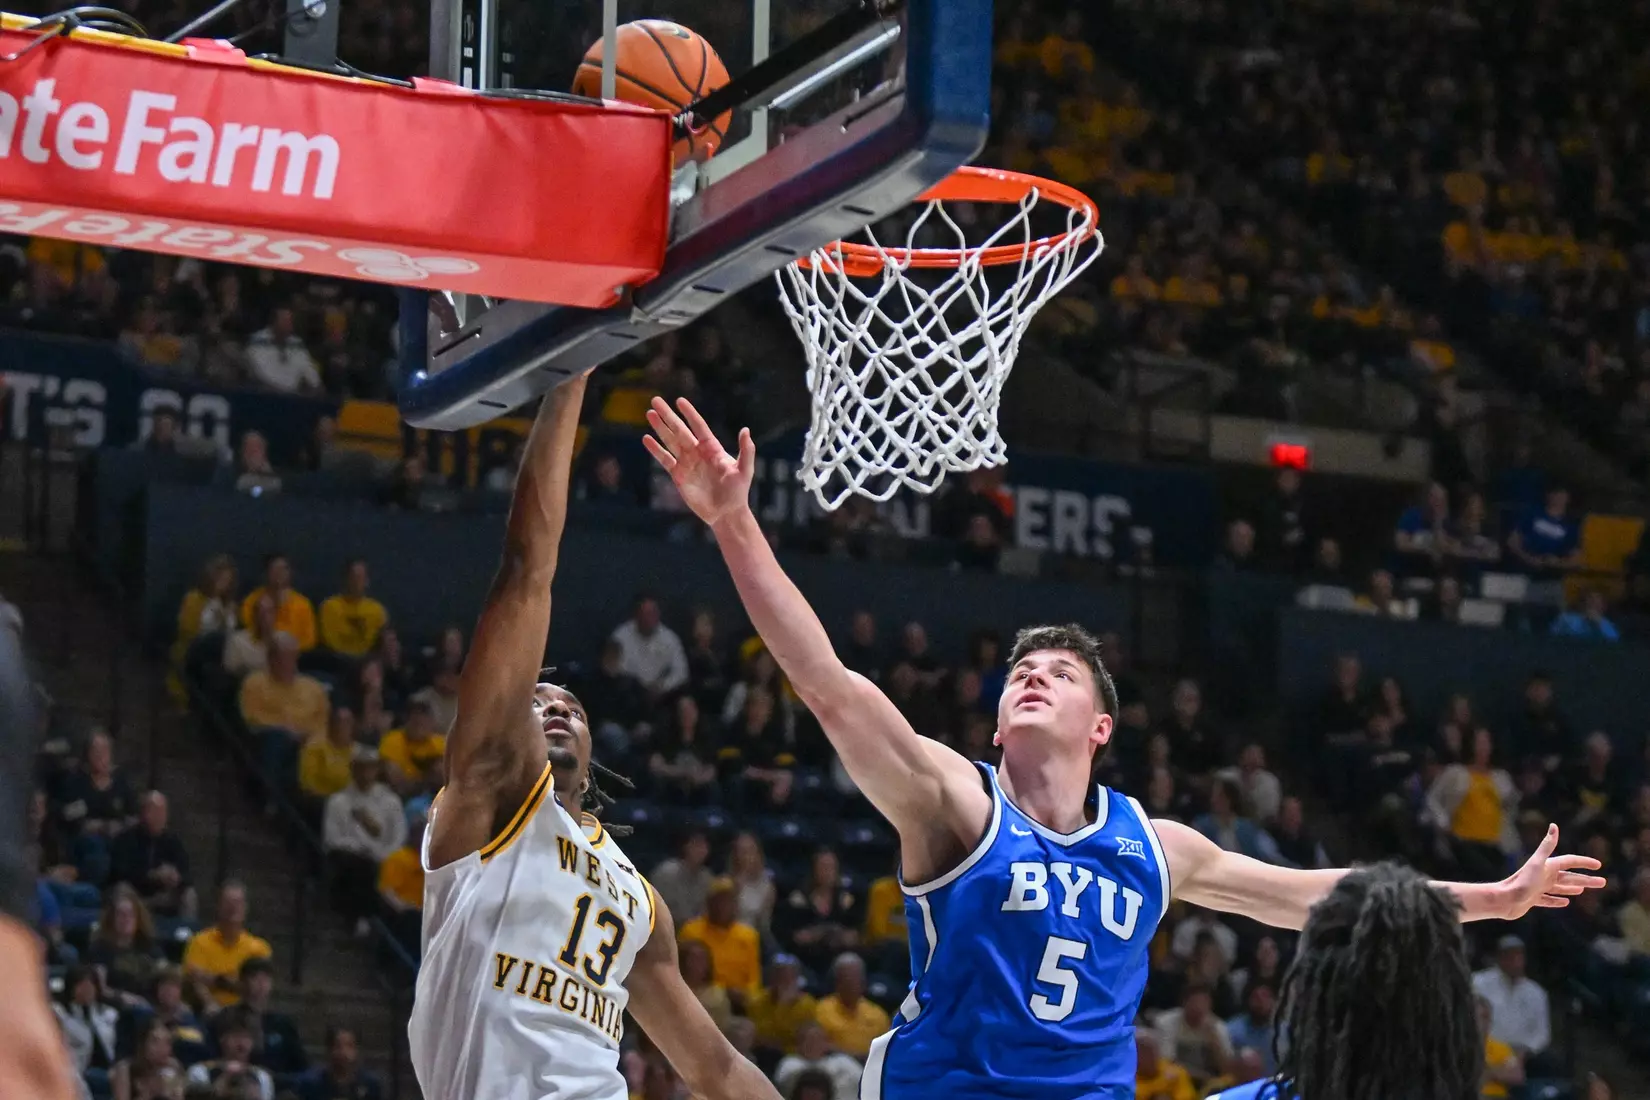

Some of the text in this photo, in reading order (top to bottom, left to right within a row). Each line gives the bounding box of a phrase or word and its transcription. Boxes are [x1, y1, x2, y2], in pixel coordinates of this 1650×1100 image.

[556, 834, 639, 922] WEST
[1001, 861, 1144, 941] BYU
[557, 892, 627, 988] 13
[1029, 935, 1087, 1022] 5
[493, 952, 624, 1042] VIRGINIA
